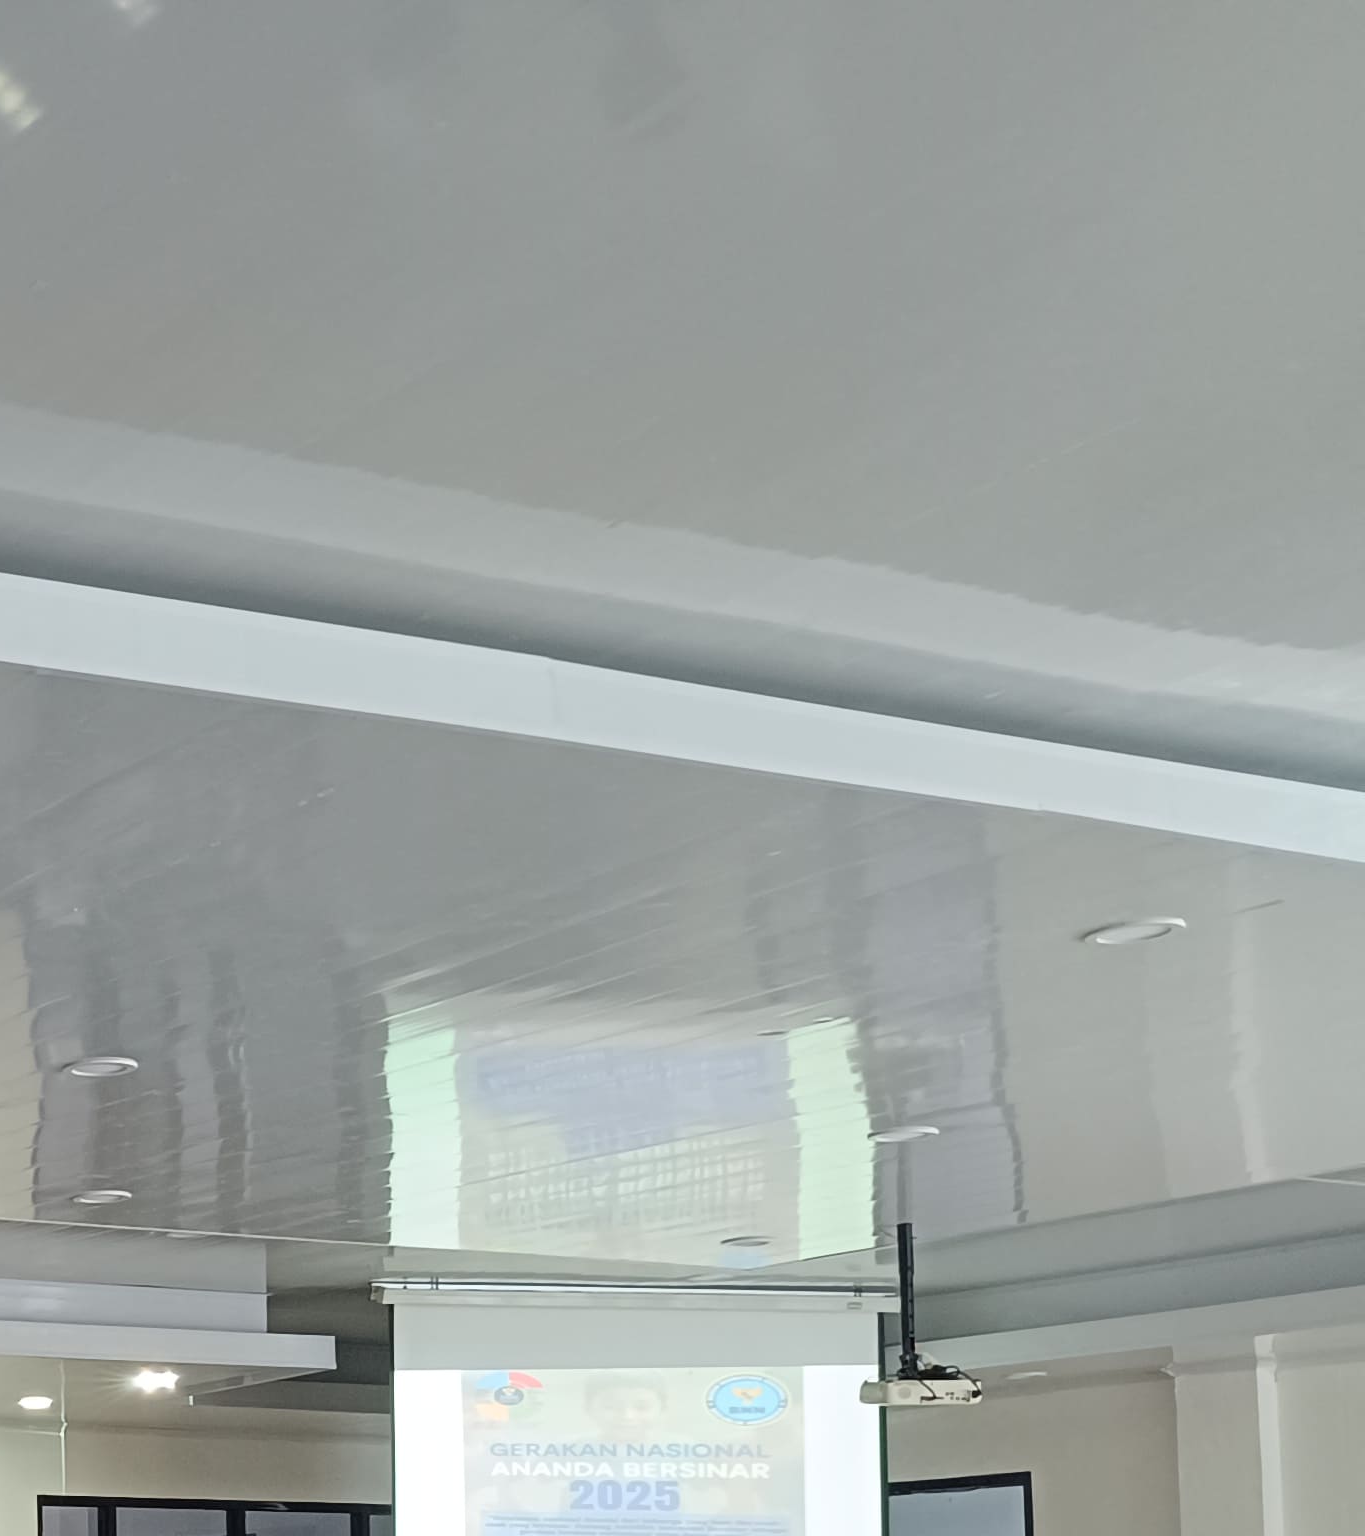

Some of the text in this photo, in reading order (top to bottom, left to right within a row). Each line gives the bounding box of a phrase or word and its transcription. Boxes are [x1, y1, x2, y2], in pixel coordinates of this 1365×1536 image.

[488, 1442, 773, 1459] GERAKAN NASIONAL
[490, 1461, 771, 1480] ANANDA BERSINAR
[568, 1480, 681, 1512] 2025
